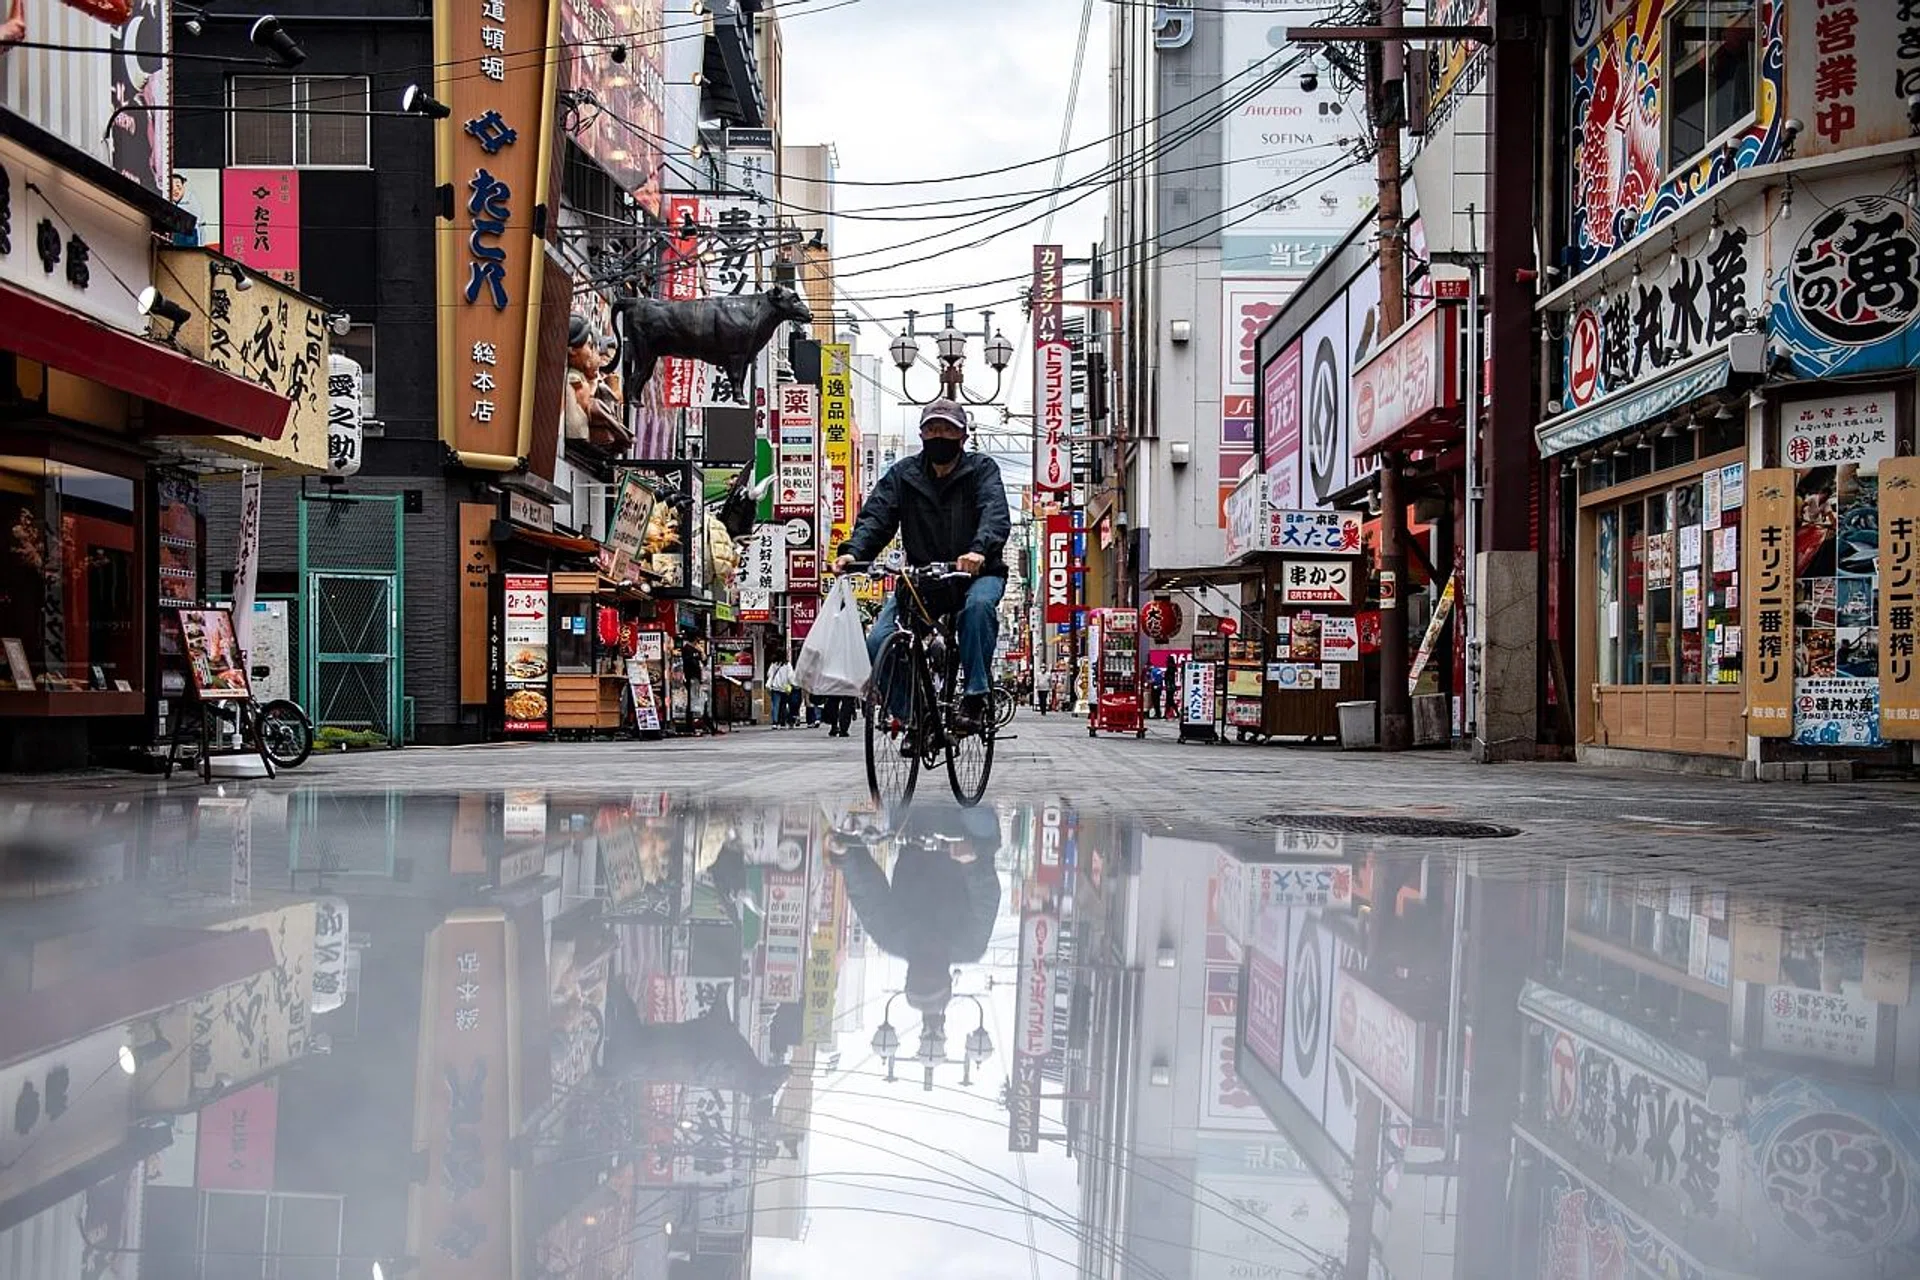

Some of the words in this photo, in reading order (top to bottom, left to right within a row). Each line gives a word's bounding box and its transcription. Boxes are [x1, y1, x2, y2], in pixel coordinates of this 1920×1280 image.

[1815, 0, 1859, 144] 営業中
[1241, 105, 1302, 116] SHISEIDO
[1262, 133, 1314, 145] SOFINA
[253, 205, 270, 251] たこ八
[465, 167, 511, 312] たこ八
[1601, 226, 1748, 392] 磯丸水産
[471, 341, 496, 422] 総本店
[785, 389, 808, 413] 薬
[827, 379, 845, 443] 逸品堂
[1815, 445, 1866, 462] 磯丸焼き
[1282, 524, 1341, 547] 大たこ
[759, 535, 773, 589] お好み焼
[1290, 565, 1346, 586] 串かつ
[1759, 525, 1782, 683] キリン一番搾り
[1890, 517, 1914, 683] キリン一番搾り
[1190, 687, 1202, 720] 大たこ
[1752, 707, 1787, 719] 取扱店
